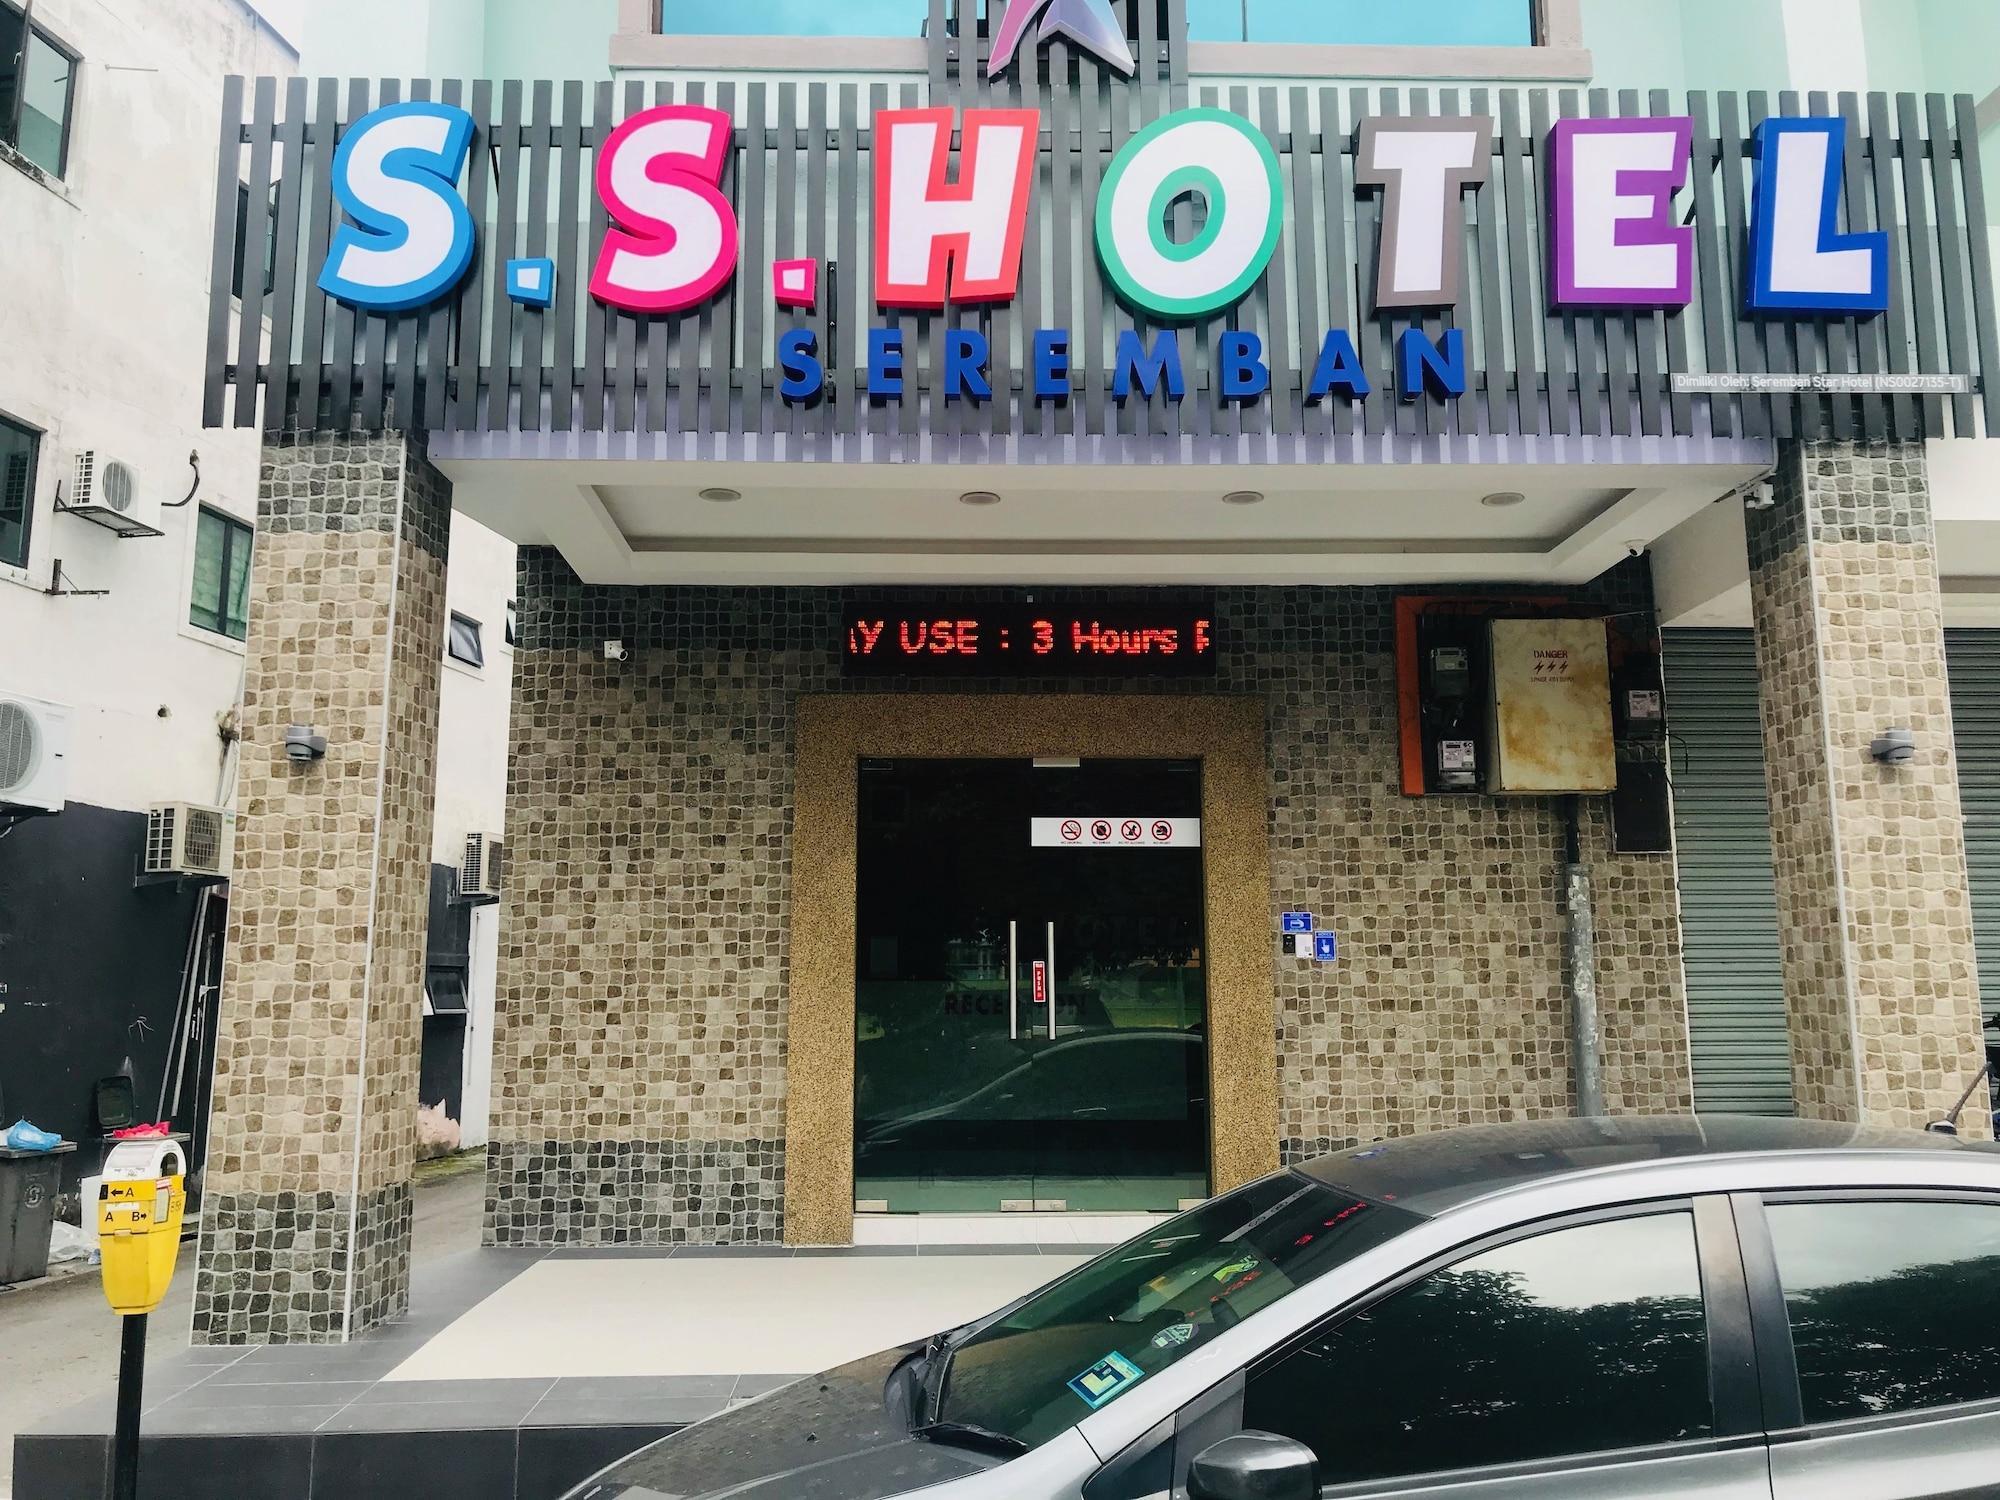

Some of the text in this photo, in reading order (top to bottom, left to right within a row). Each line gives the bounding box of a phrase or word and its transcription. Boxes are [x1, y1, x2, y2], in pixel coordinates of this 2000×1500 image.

[778, 328, 1465, 402] SEREMBAN
[1677, 375, 1718, 387] Dimiliki
[1720, 375, 1750, 388] Oleh:
[1752, 375, 1811, 388] Seremban
[1813, 375, 1839, 388] Star
[1841, 375, 1873, 388] Hotel
[850, 620, 884, 654] Y
[900, 620, 978, 654] USE
[1032, 620, 1054, 654] 3
[1072, 620, 1178, 654] Hours
[1533, 650, 1568, 659] DANGER
[125, 1187, 134, 1197] A
[104, 1211, 140, 1222] A B
